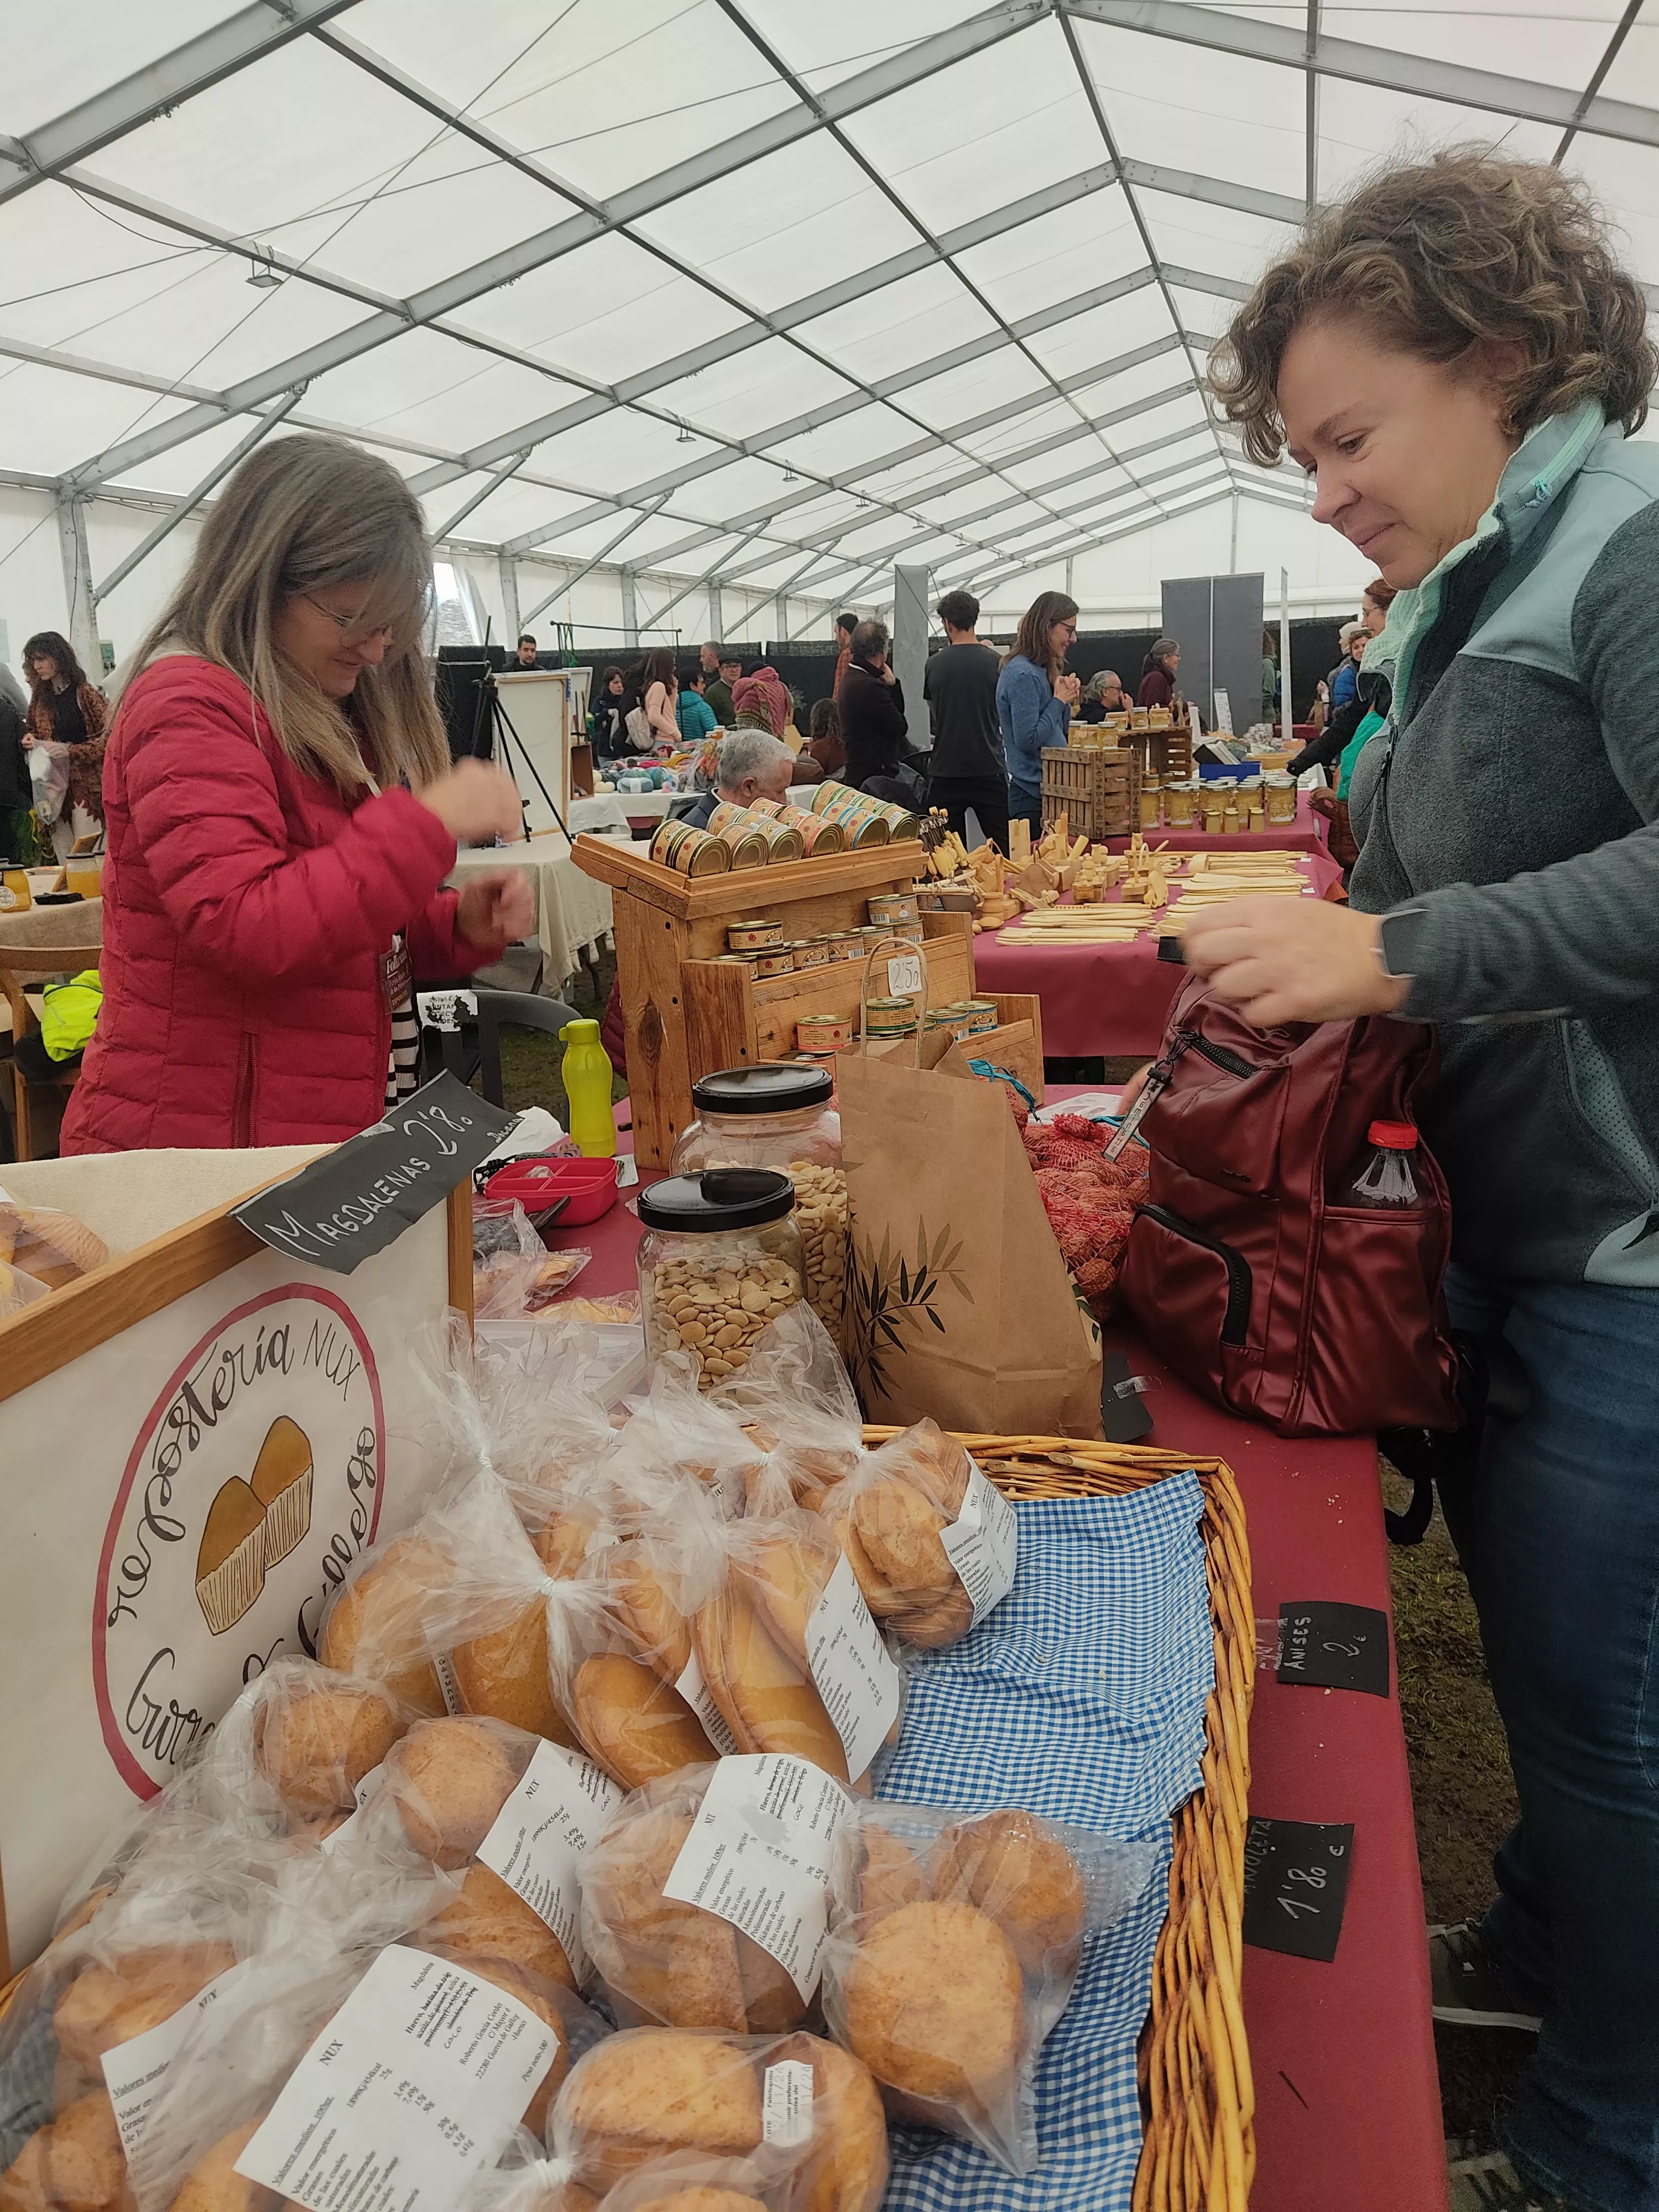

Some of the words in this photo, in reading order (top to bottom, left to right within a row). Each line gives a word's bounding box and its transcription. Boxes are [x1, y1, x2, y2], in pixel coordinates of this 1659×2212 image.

[893, 961, 919, 989] 2'50
[970, 1494, 978, 1509] NUX
[953, 1556, 964, 1565] Valor
[958, 1560, 970, 1571] Grasas
[1283, 1616, 1312, 1671] ANISES
[701, 1701, 711, 1713] Valor
[719, 1731, 732, 1745] Hidra
[525, 1778, 540, 1799] NUX
[759, 1792, 772, 1811] Huevo,
[560, 1813, 571, 1824] 25g
[809, 1813, 820, 1830] Roberto
[815, 1797, 825, 1813] Gracia
[500, 1858, 515, 1879] Valores
[513, 1873, 524, 1890] Valor
[692, 1880, 707, 1904] Valores
[704, 1863, 716, 1881] medios
[709, 1895, 721, 1910] Valor
[719, 1867, 734, 1895] energético
[719, 1895, 732, 1915] Grasas
[728, 1910, 735, 1919] de
[736, 1886, 747, 1903] cuales
[737, 1898, 752, 1924] saturadas
[758, 1919, 773, 1944] Hidratos
[770, 1912, 775, 1921] de
[774, 1891, 785, 1912] carbono
[766, 1942, 773, 1950] de
[780, 1947, 790, 1964] Fibra
[410, 1962, 434, 1990] Magdalena
[448, 1976, 460, 1991] azúca
[405, 2012, 425, 2034] Huevo,
[441, 1971, 452, 1984] trig
[466, 1986, 479, 1998] Trig
[488, 2030, 496, 2039] C/
[492, 2012, 508, 2031] Mayor
[318, 2038, 345, 2067] NUX
[459, 2041, 478, 2065] Roberto
[476, 2021, 491, 2040] Gracia
[476, 2059, 491, 2080] 22280
[500, 2032, 508, 2040] de
[504, 2013, 520, 2032] Galleg
[379, 2068, 393, 2080] 25g
[112, 2078, 145, 2100] Valores
[415, 2094, 427, 2106] 15g
[118, 2103, 142, 2121] Valor
[437, 2117, 451, 2131] 30g
[272, 2153, 296, 2188] Valores
[294, 2123, 315, 2153] medios
[291, 2171, 310, 2195] Valor
[309, 2128, 337, 2171] energético
[302, 2171, 324, 2201] Grasas
[313, 2195, 323, 2207] de
[319, 2180, 331, 2194] las
[330, 2153, 348, 2179] cuales
[326, 2168, 352, 2209] saturadas
